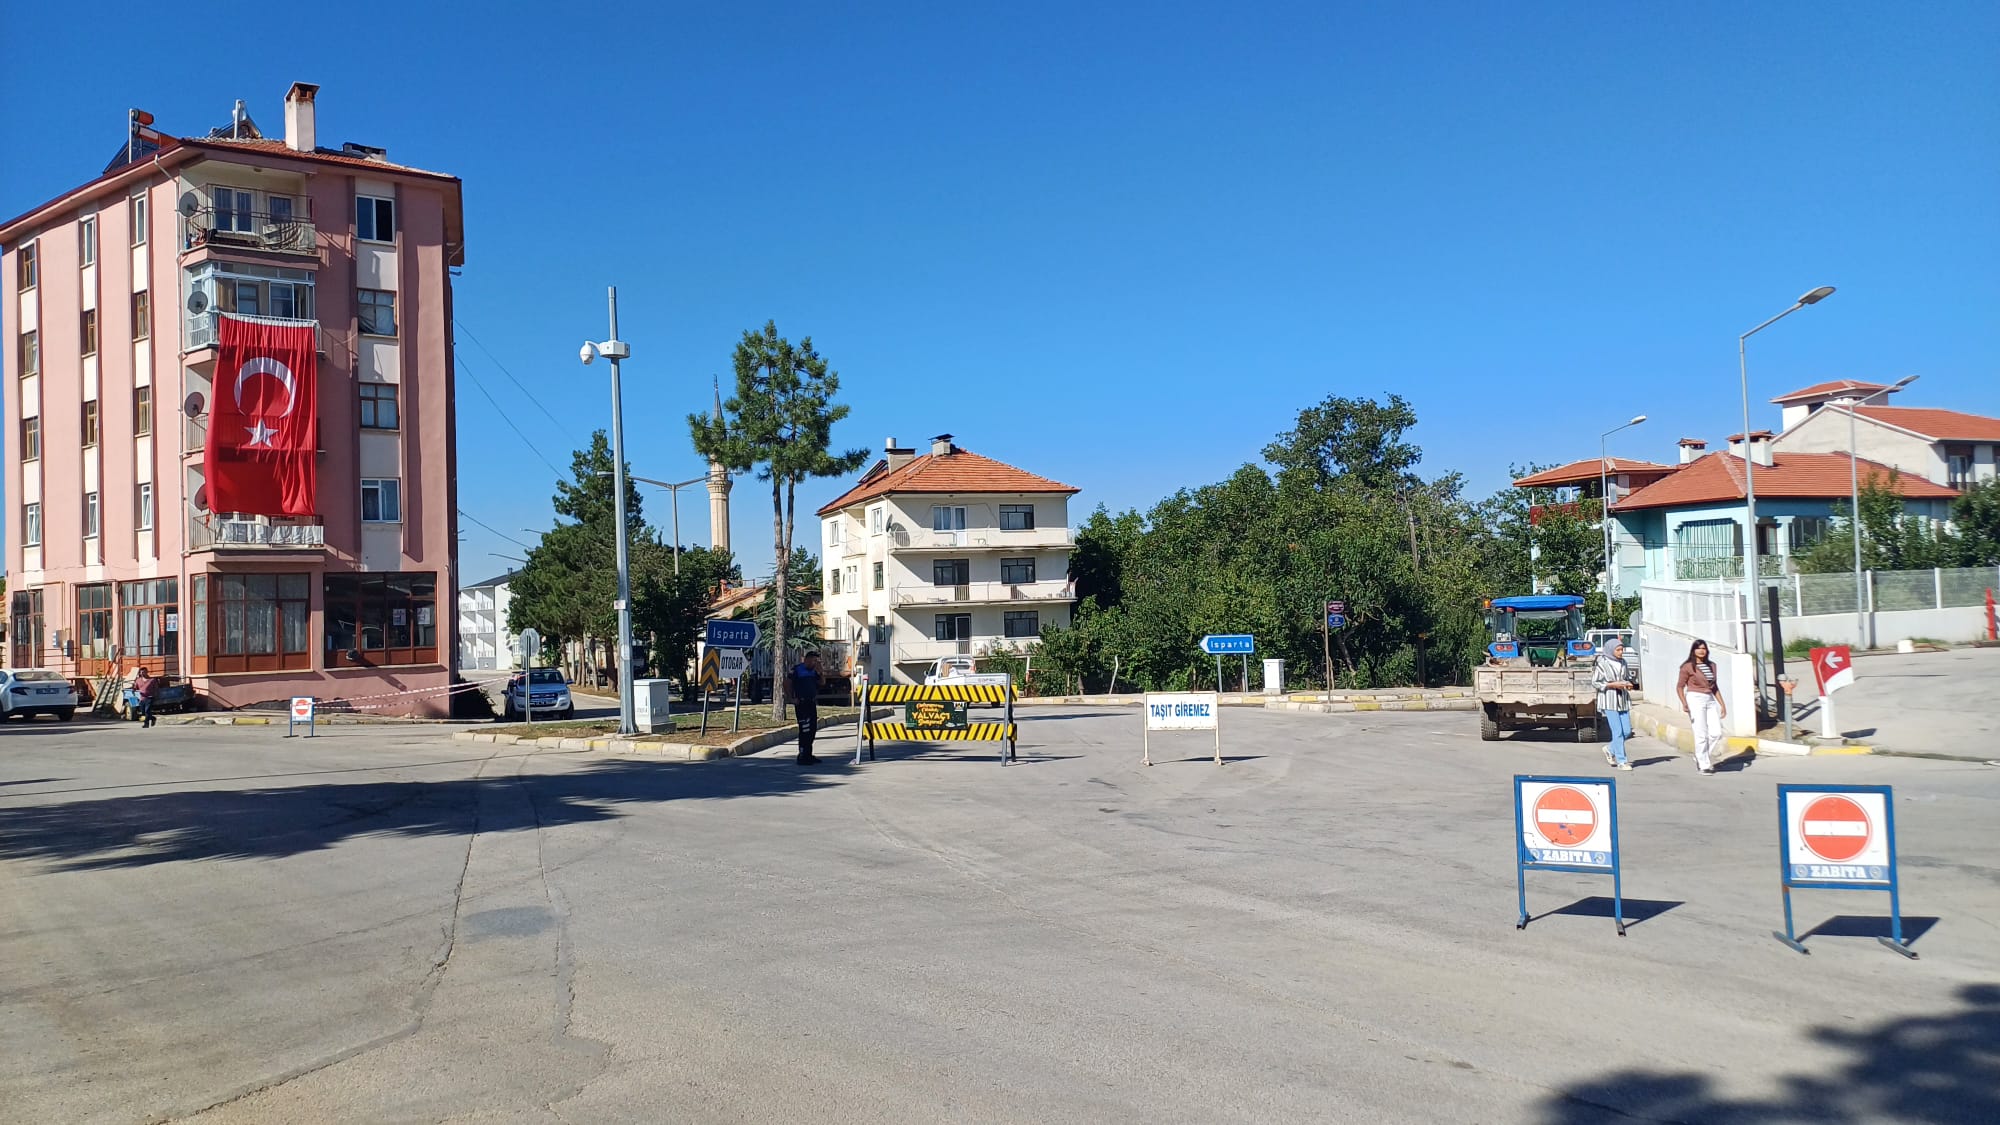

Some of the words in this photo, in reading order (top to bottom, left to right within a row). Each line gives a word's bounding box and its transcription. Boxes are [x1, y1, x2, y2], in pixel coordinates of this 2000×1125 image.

[713, 627, 749, 643] Isparta
[1210, 640, 1250, 650] Isparta
[721, 656, 743, 670] OTOGAR
[1150, 703, 1172, 720] TAŞIT
[1175, 700, 1210, 717] GİREMEZ
